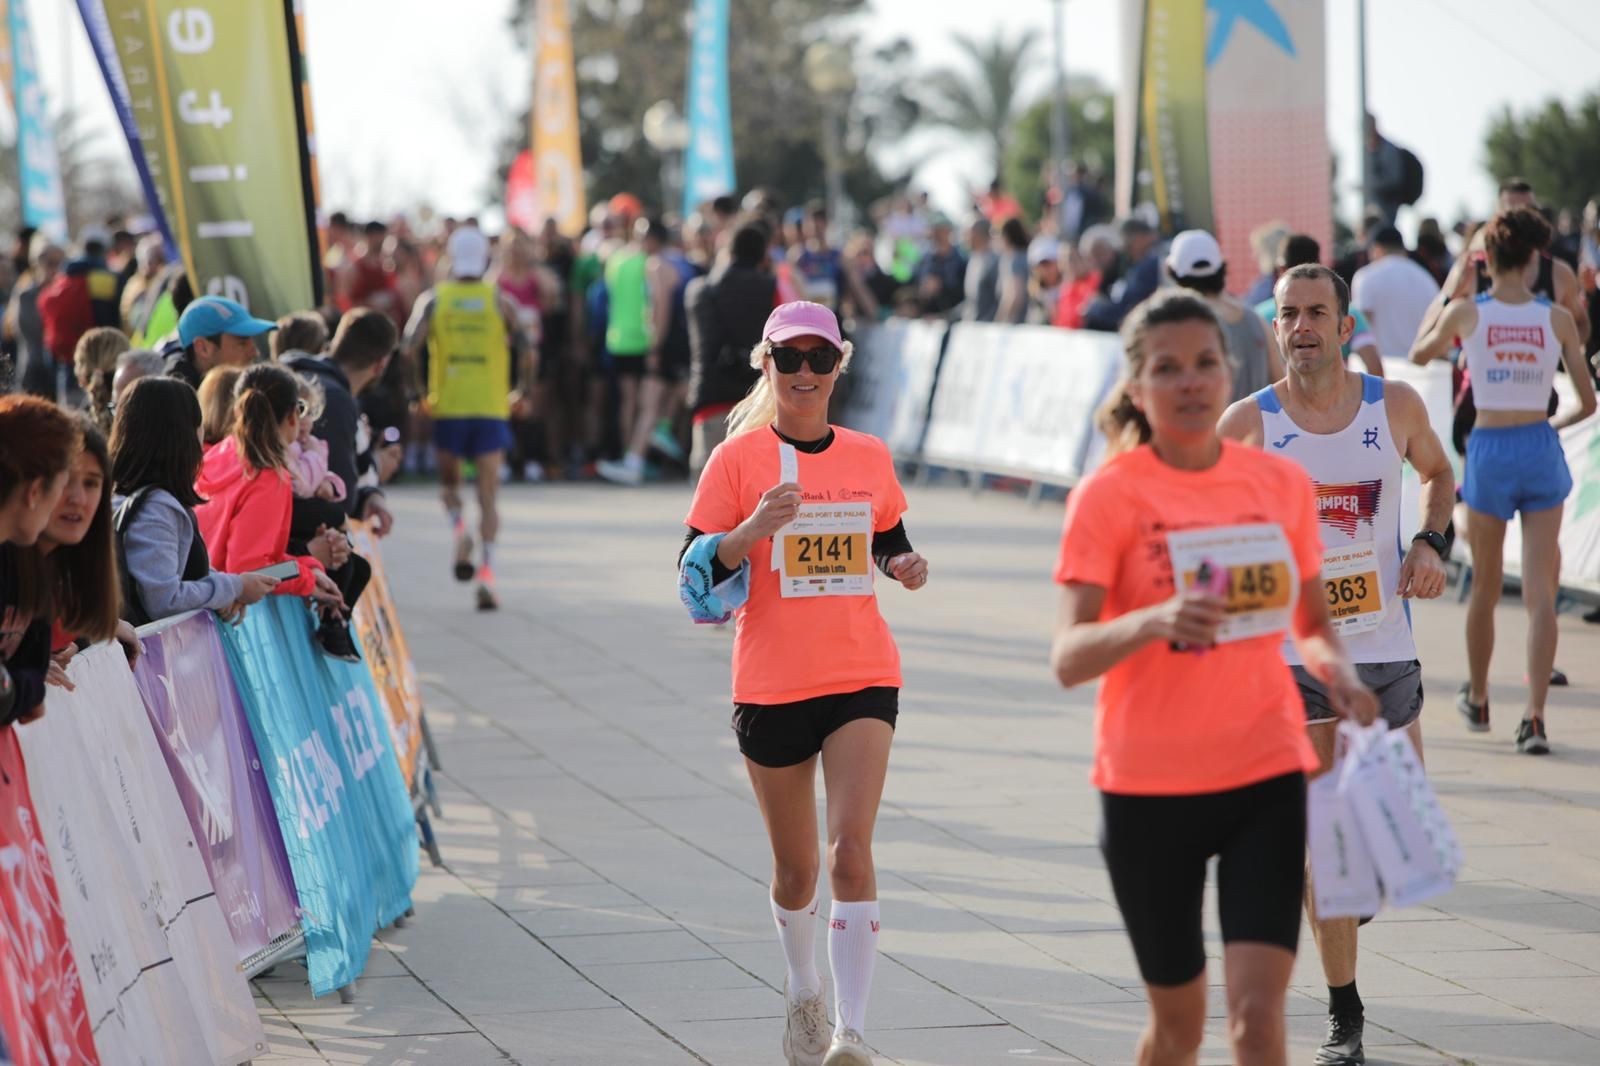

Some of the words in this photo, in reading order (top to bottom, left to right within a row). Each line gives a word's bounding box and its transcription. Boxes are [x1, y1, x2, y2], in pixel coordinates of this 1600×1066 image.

[1495, 352, 1537, 363] VIVA
[1317, 495, 1359, 514] AMPER
[797, 535, 852, 562] 2141
[1325, 576, 1367, 605] 363
